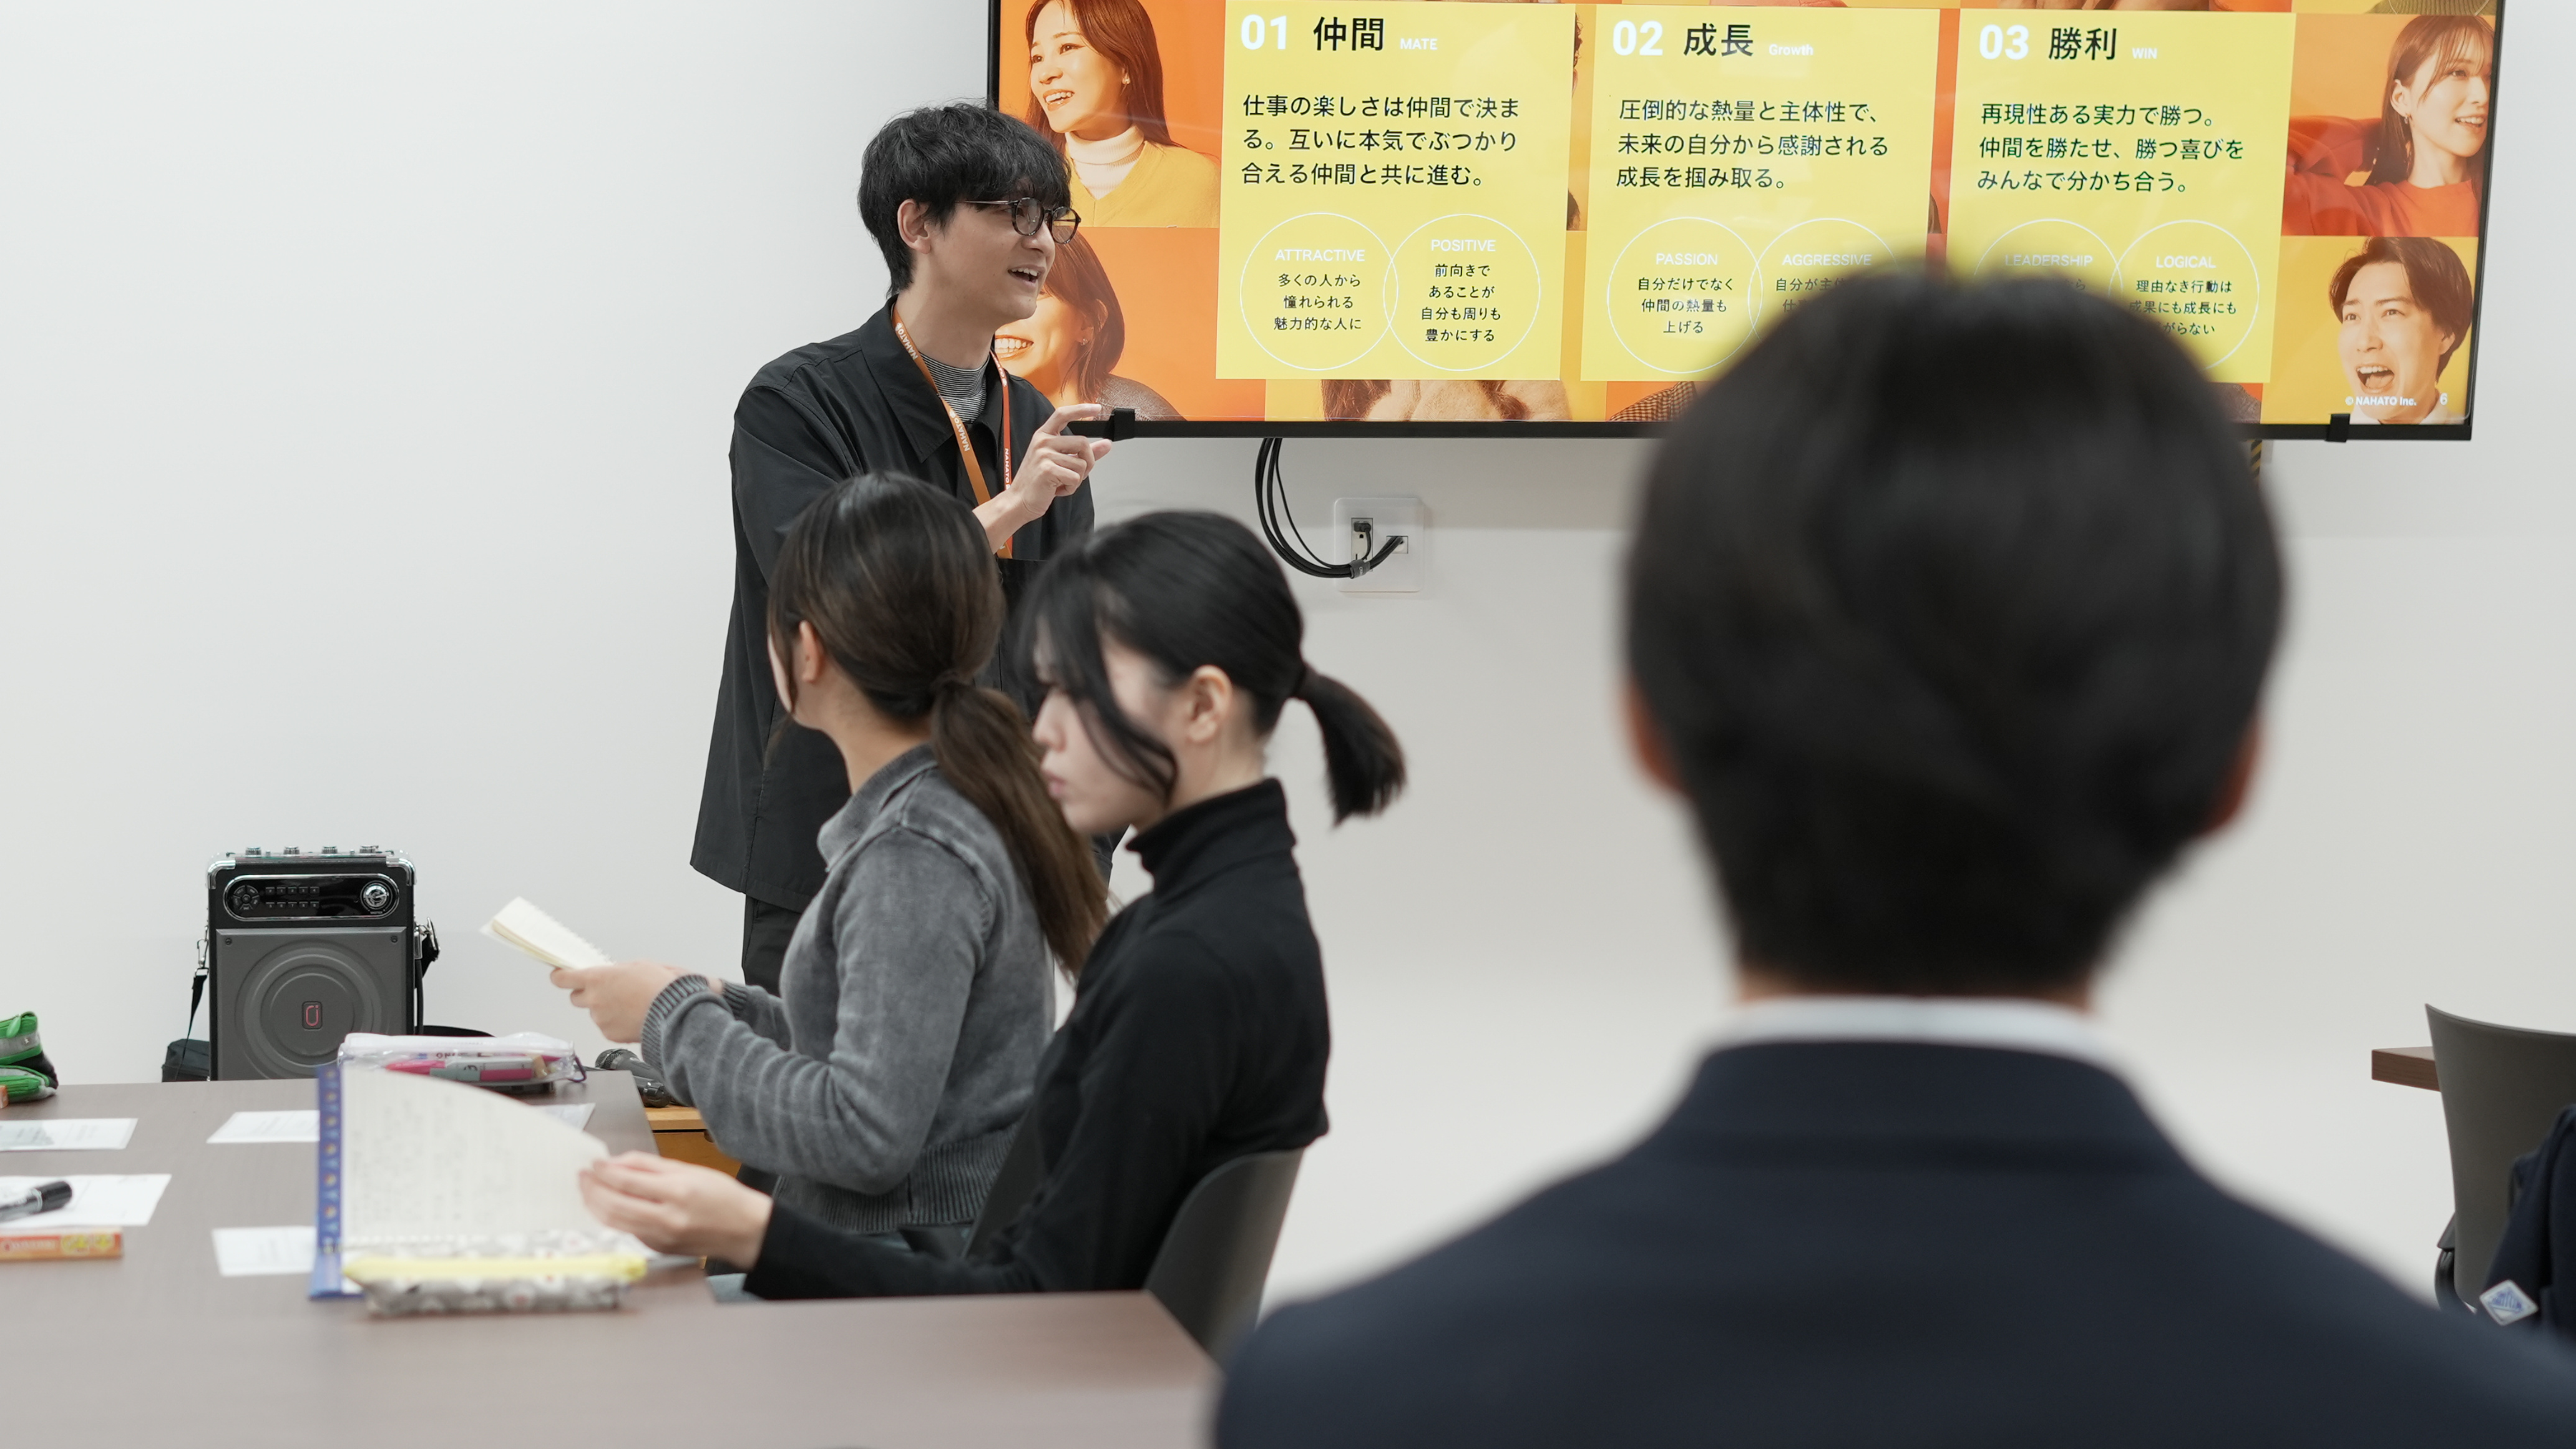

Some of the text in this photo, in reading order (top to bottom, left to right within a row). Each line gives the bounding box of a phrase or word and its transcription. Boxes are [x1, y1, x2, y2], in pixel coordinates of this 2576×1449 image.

[1240, 14, 1438, 52] 01 仲間 MATE
[1613, 19, 1814, 57] 02 成長 Growth
[1979, 24, 2158, 61] 03 勝利 WIN
[1242, 94, 1518, 119] 仕事の楽しさは仲間で決ま
[1619, 99, 1876, 123] 圧倒的な熱量と主体性で、
[1980, 102, 2213, 127] 再現性ある実力で勝つ。
[1243, 129, 1516, 152] る。互いに本気でぶつかり
[1618, 132, 1888, 157] 未来の自分から感謝される
[1979, 137, 2243, 160] 仲間を勝たせ、勝つ喜びを
[1241, 162, 1481, 187] 合える仲間と共に進む。
[1616, 165, 1784, 189] 成長を掴み取る。
[1977, 170, 2185, 192] みんなで分かち合う。
[1430, 238, 1496, 252] POSITIVE
[1274, 248, 1365, 262] ATTRACTIVE
[1656, 253, 1718, 265] PASSION
[1782, 253, 1870, 266] AGGRESSIVE
[2004, 253, 2094, 267] LEADERSHIP
[2156, 255, 2217, 269] LOGICAL
[1435, 263, 1491, 278] 前向きで
[1278, 273, 1360, 288] 多くの人から
[1638, 277, 1732, 291] 自分だけでなく
[2136, 280, 2231, 293] 理由なき行動は
[1428, 285, 1495, 299] あることが
[1283, 295, 1353, 309] 憧れられる
[1641, 298, 1727, 313] 仲間の熱量も
[1421, 306, 1501, 321] 自分も周りも
[1274, 316, 1361, 331] 魅力的な人に
[1663, 320, 1703, 333] 上げる
[1425, 328, 1495, 342] 豊かにする
[897, 328, 919, 361] NAHATO
[2355, 396, 2397, 406] NAHATO
[2399, 396, 2417, 406] Inc.
[2439, 392, 2448, 406] 6
[954, 416, 971, 452] NAHATO
